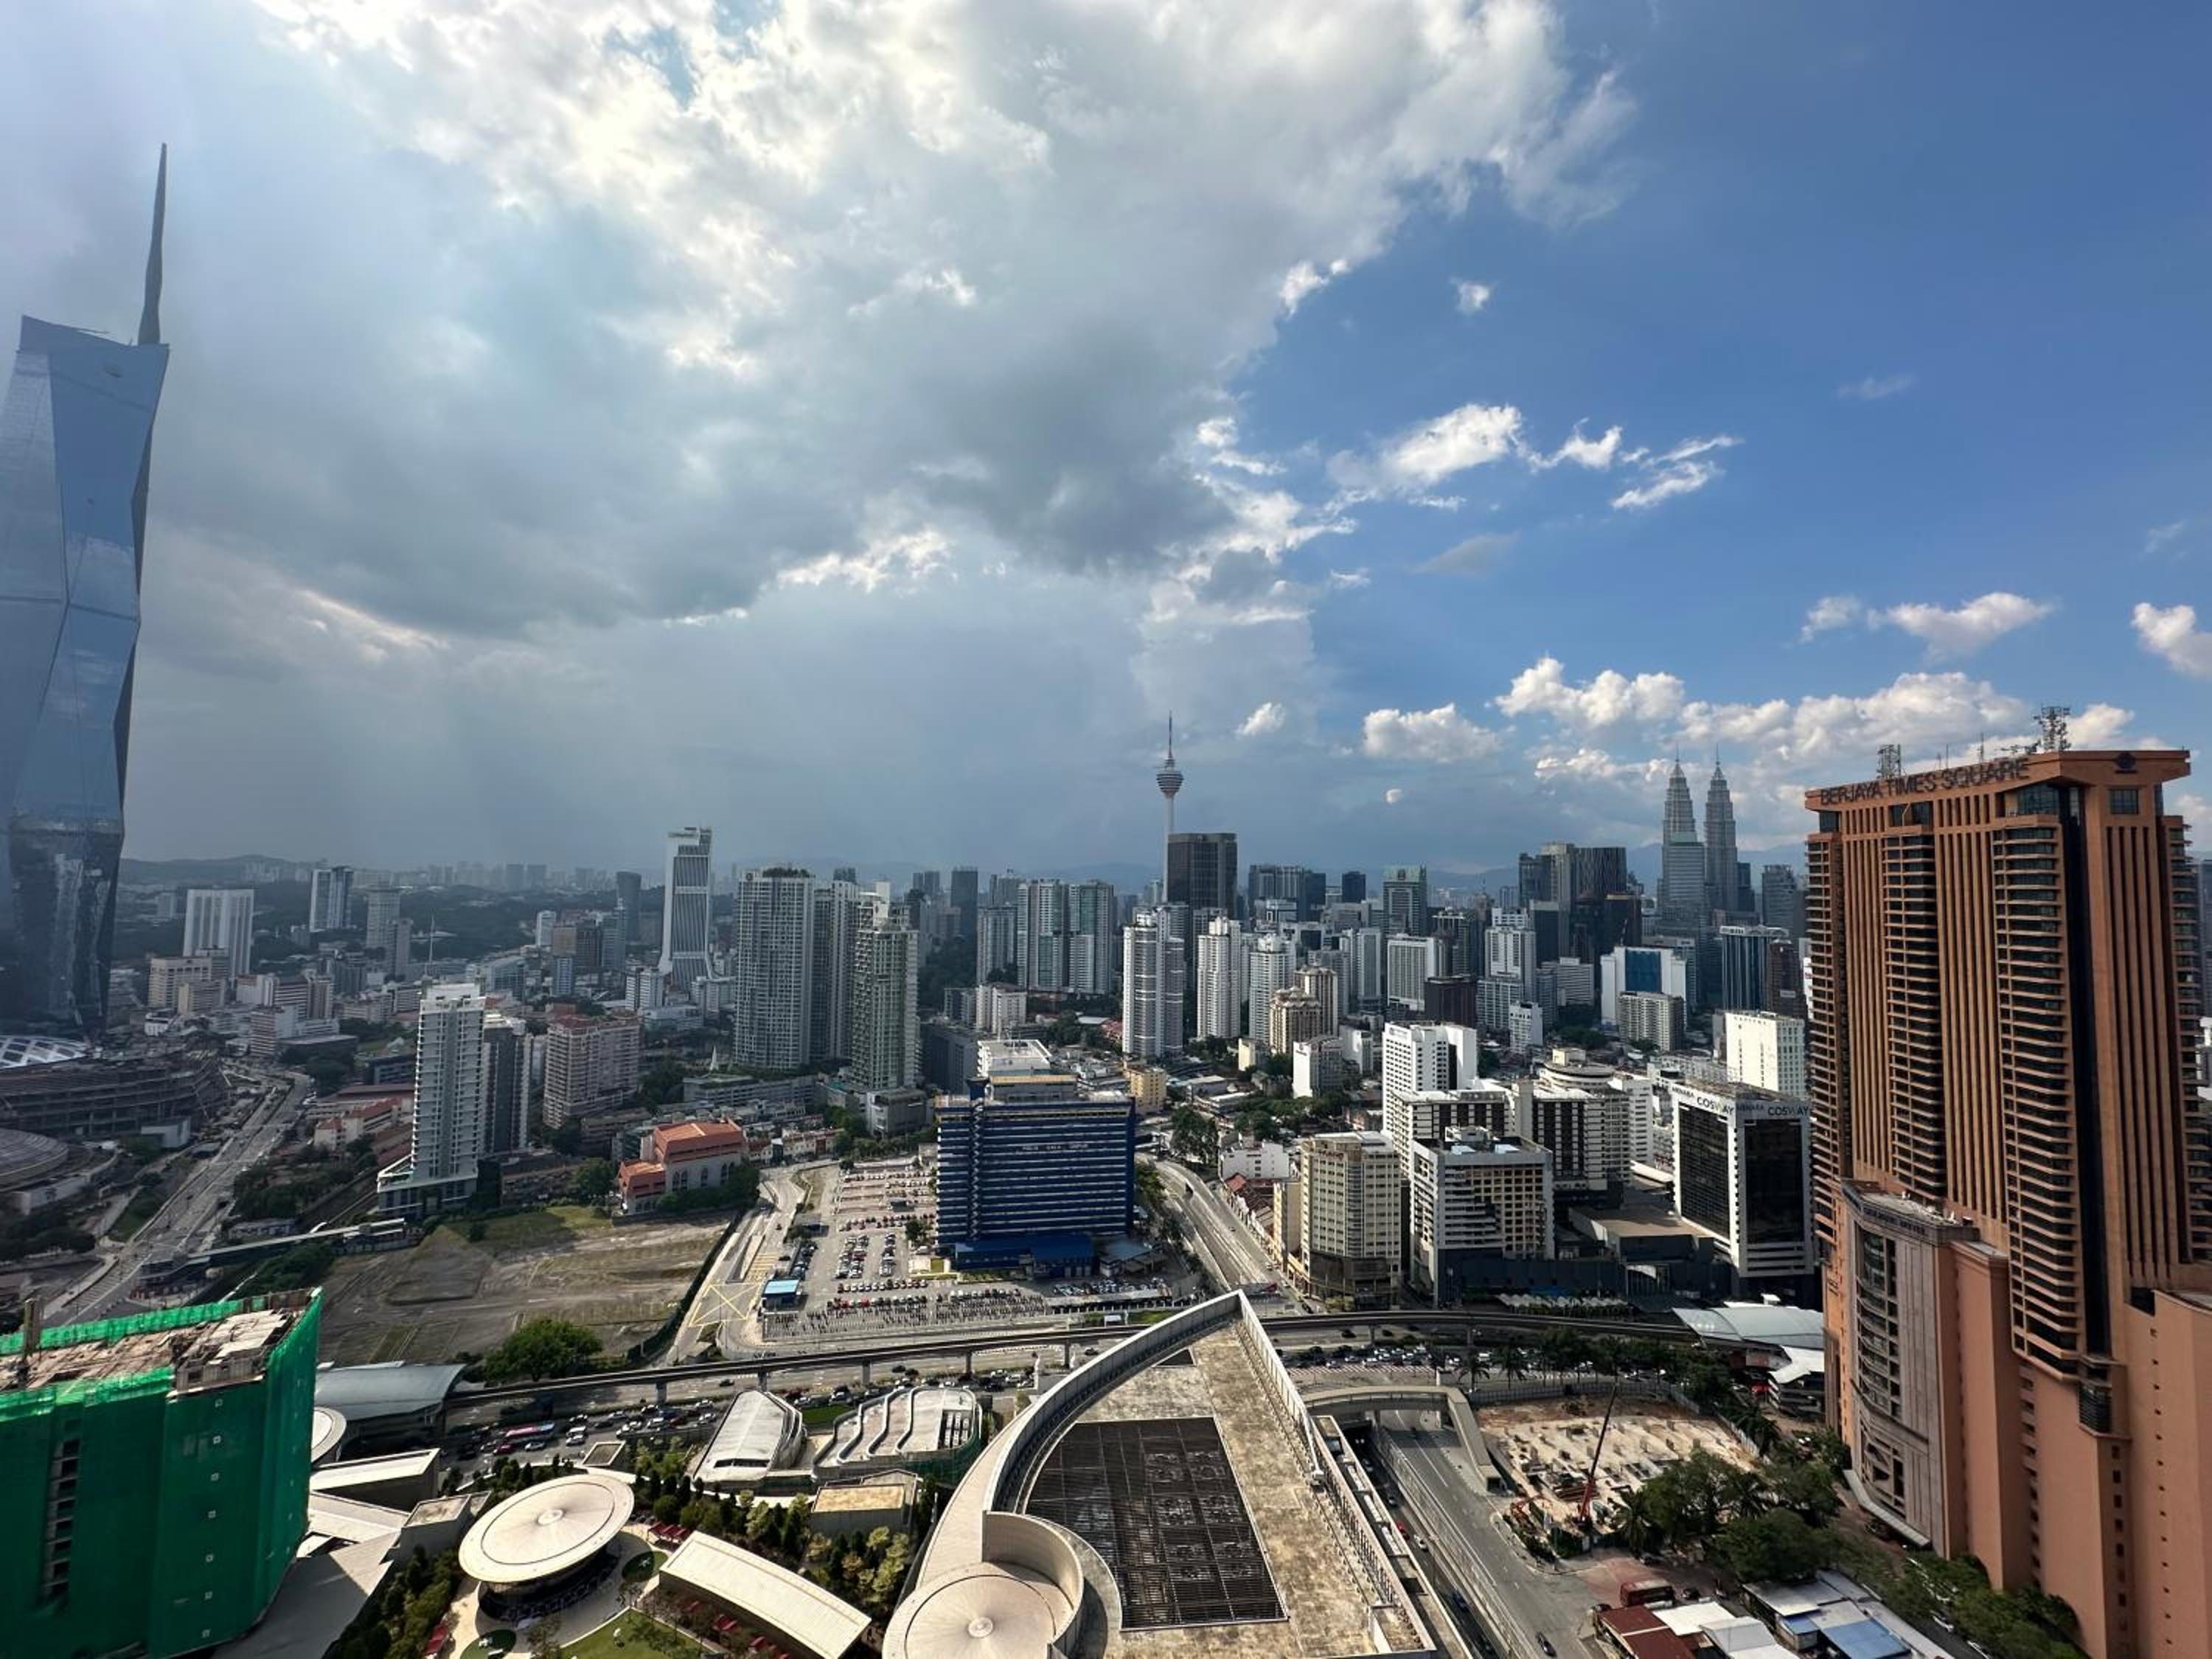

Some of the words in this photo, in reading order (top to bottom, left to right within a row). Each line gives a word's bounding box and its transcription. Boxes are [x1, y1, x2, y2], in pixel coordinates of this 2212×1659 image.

[1820, 780, 1882, 805] BERJAYA
[1886, 772, 1937, 796] TIMES
[1941, 757, 2030, 790] SQUARE
[1697, 1096, 1734, 1115] COSWAY
[1768, 1105, 1809, 1116] COSWAY
